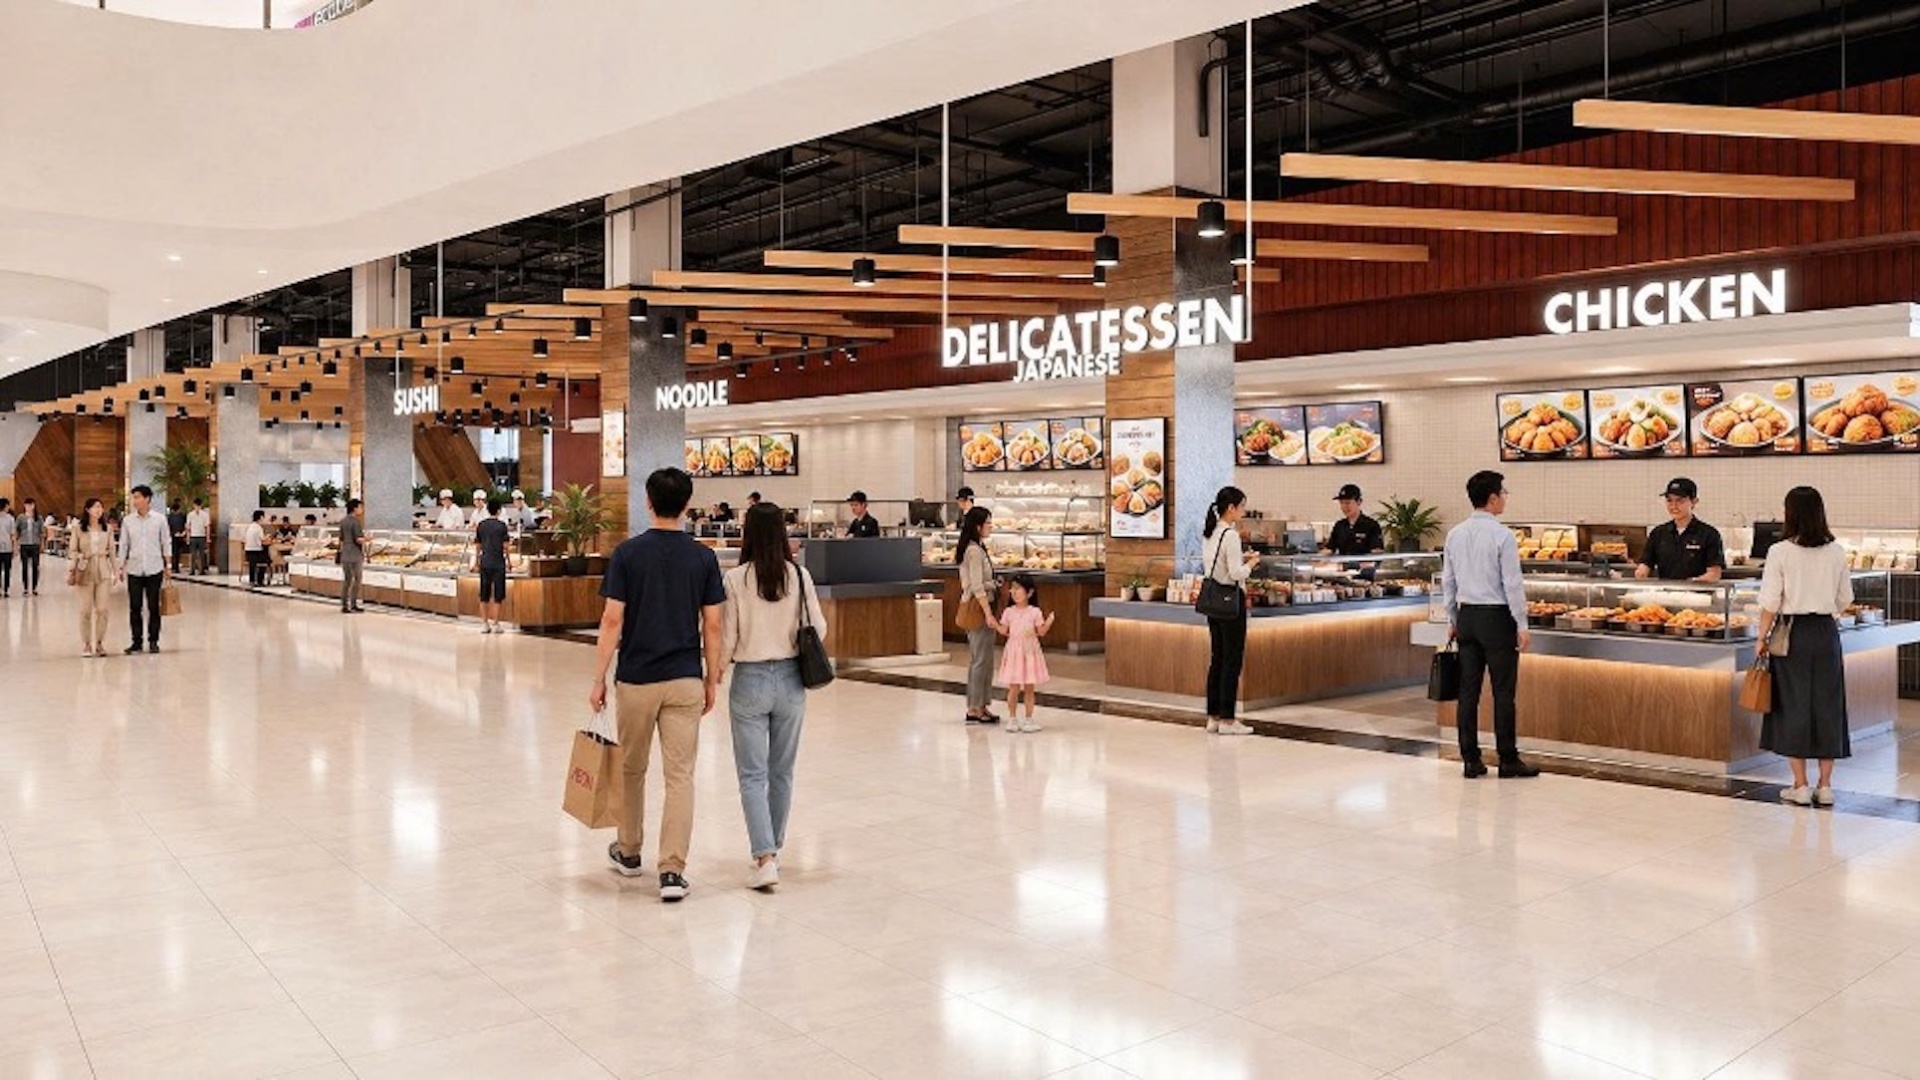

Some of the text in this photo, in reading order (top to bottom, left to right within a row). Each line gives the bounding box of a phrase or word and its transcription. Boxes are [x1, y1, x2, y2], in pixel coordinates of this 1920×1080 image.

[1544, 268, 1786, 334] CHICKEN
[942, 294, 1243, 367] DELICATESSEN
[1013, 351, 1120, 383] JAPANESE
[393, 384, 439, 415] SUSHI
[656, 379, 728, 411] NOODLE
